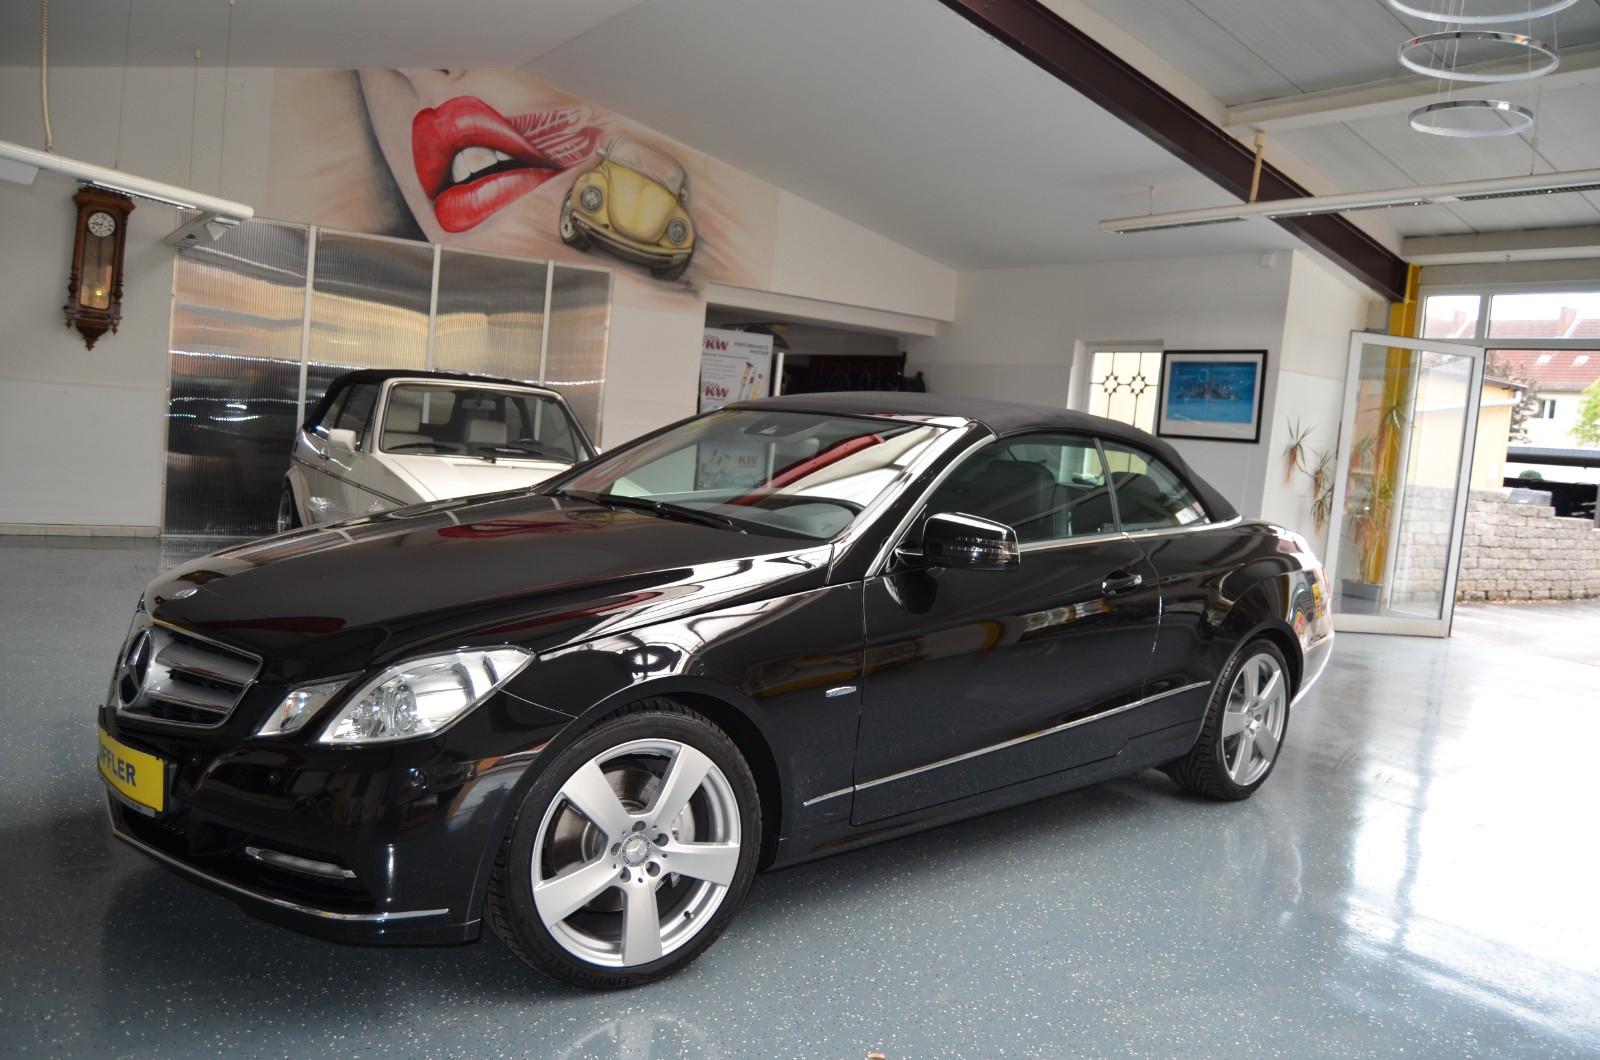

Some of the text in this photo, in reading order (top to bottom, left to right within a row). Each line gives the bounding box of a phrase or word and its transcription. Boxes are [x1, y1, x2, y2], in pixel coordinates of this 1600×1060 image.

[704, 340, 729, 351] KW
[704, 387, 729, 398] KW
[100, 744, 136, 787] FFLER
